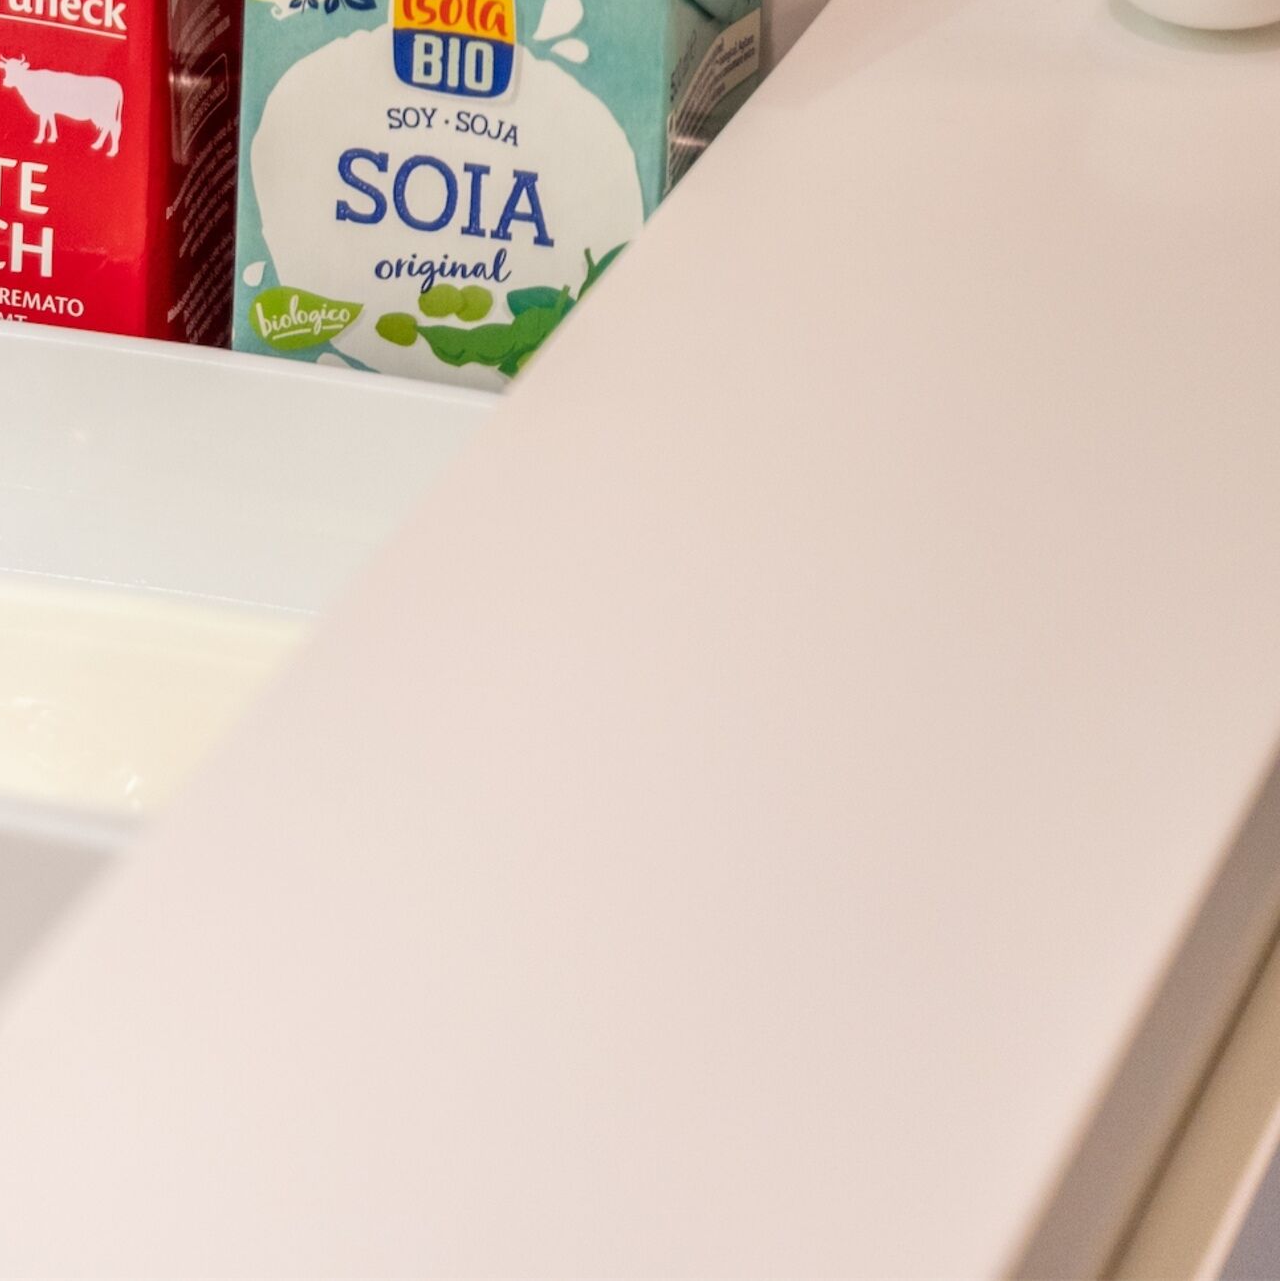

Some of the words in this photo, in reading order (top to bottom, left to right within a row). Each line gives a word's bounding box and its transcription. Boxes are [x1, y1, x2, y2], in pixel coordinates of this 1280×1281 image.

[410, 32, 495, 94] BIO
[386, 107, 440, 132] SOY
[455, 111, 520, 148] SOJA
[335, 147, 556, 249] SOIA
[374, 247, 513, 295] original
[255, 293, 351, 339] biologico
